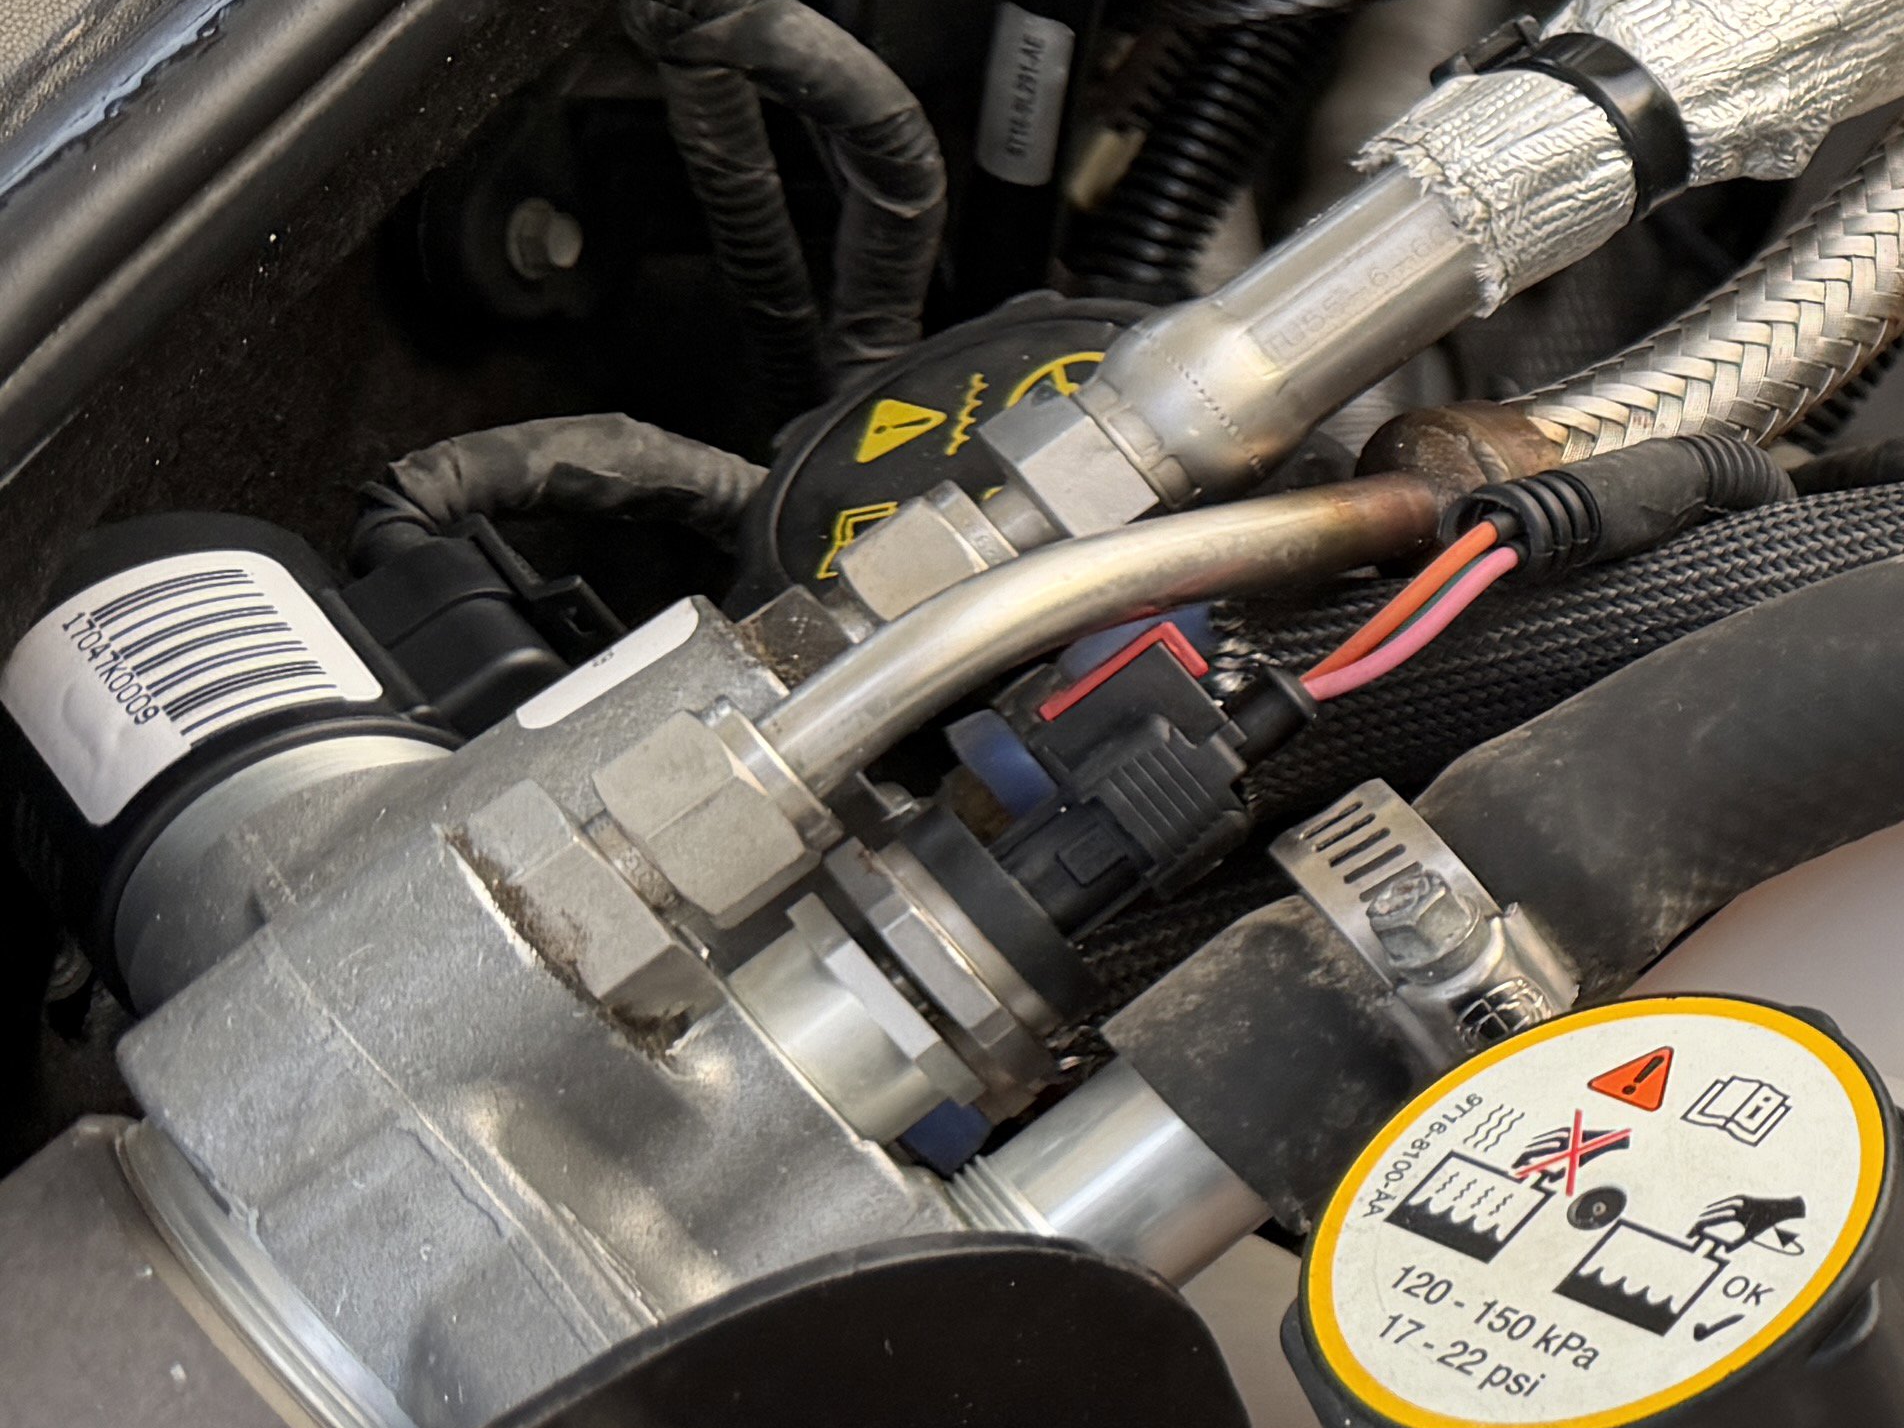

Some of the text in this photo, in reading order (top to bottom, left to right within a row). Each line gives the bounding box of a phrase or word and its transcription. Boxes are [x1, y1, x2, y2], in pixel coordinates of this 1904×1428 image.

[62, 611, 160, 726] 17047K0009
[1390, 1263, 1454, 1306] 120
[1473, 1298, 1538, 1342] 150
[1532, 1322, 1601, 1371] kPa
[1721, 1274, 1775, 1308] OK
[1378, 1311, 1426, 1345] 17
[1436, 1339, 1489, 1377] 22
[1477, 1363, 1547, 1399] psi
